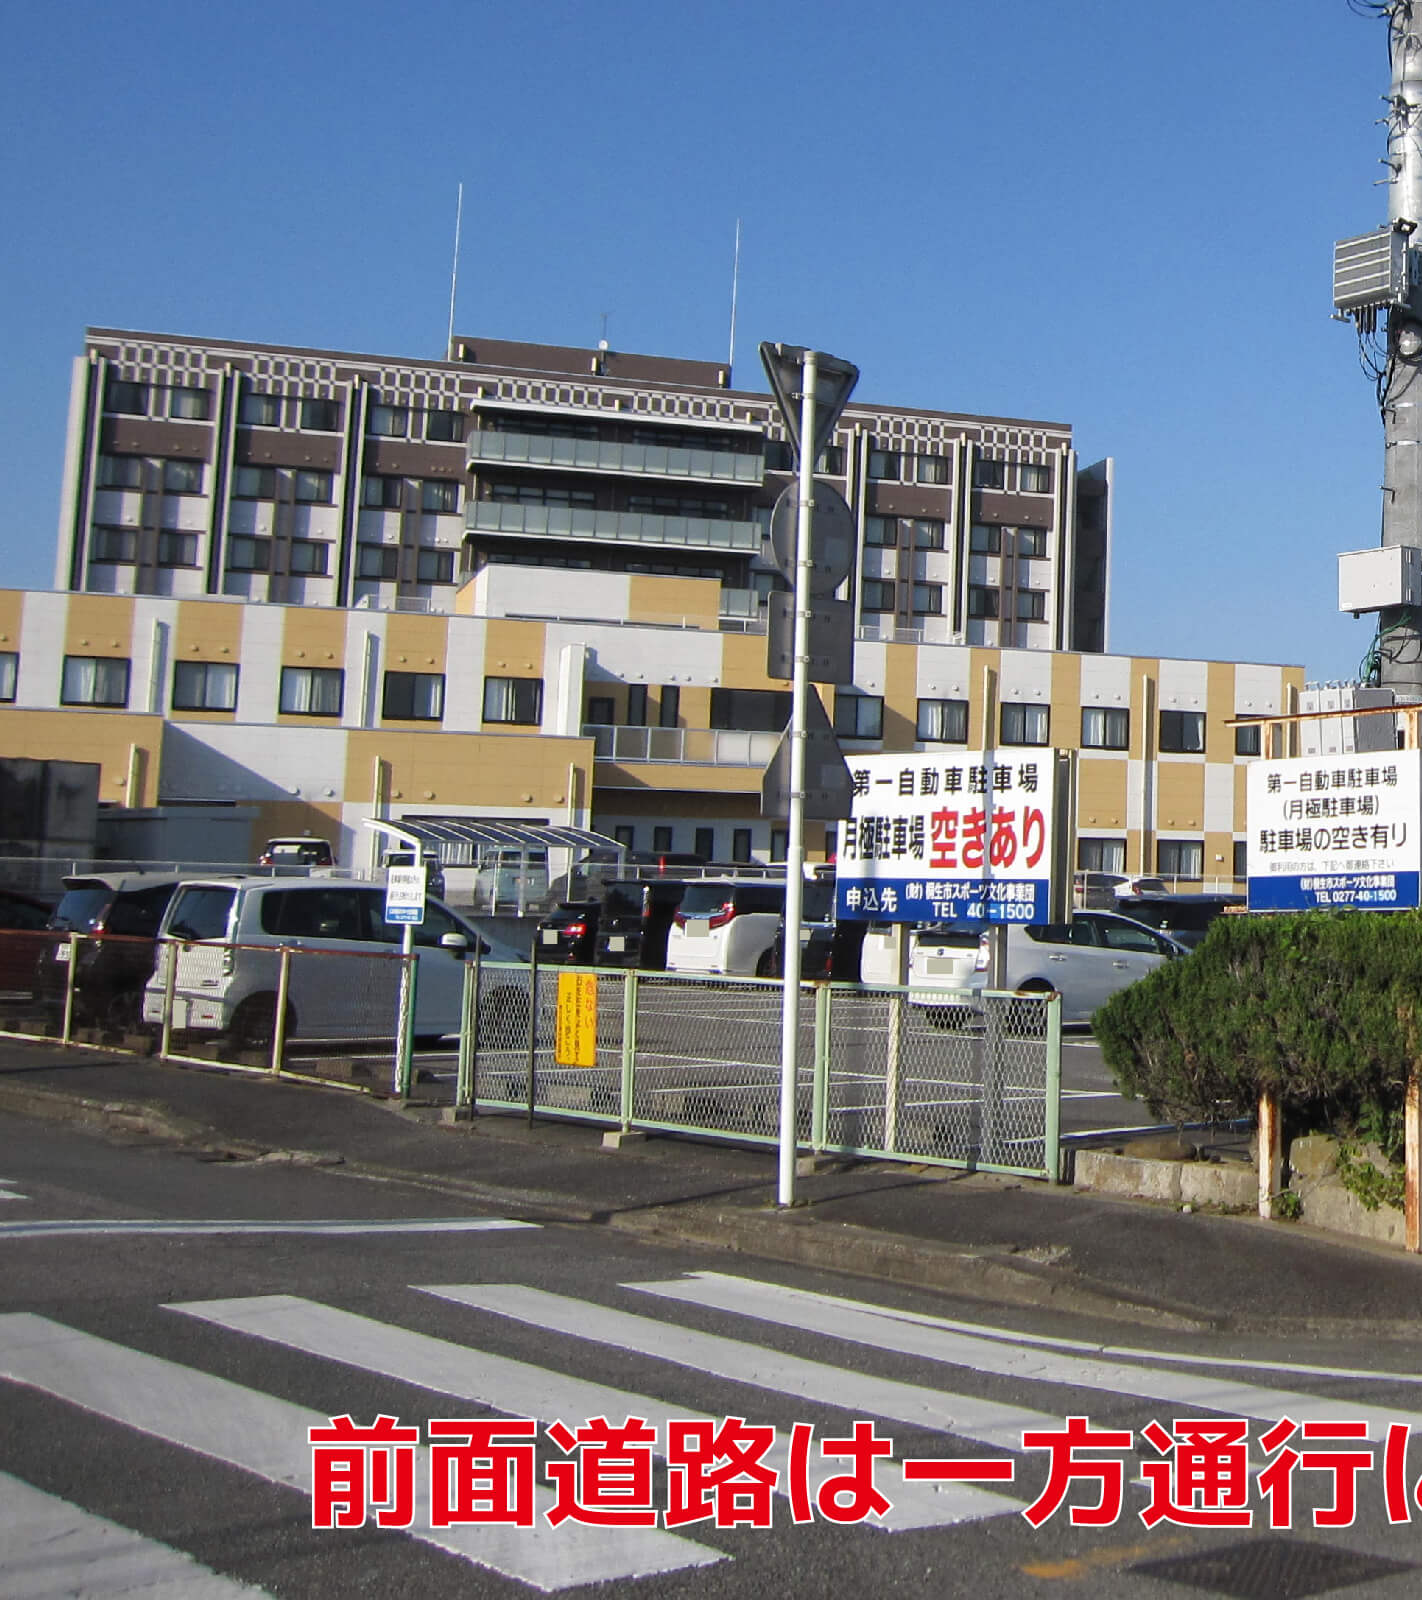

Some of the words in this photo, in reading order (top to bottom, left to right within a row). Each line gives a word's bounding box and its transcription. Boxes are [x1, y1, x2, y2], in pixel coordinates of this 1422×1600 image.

[852, 763, 1039, 797] 第一自動車駐車場
[1266, 765, 1398, 794] 第一自動車駐車場
[1283, 795, 1380, 821] (月極駐車場)
[929, 805, 1046, 869] 空きあり
[846, 886, 898, 913] 申込先
[933, 902, 957, 918] TEL
[1315, 891, 1331, 904] TEL
[1333, 889, 1397, 903] 0277-40-1500
